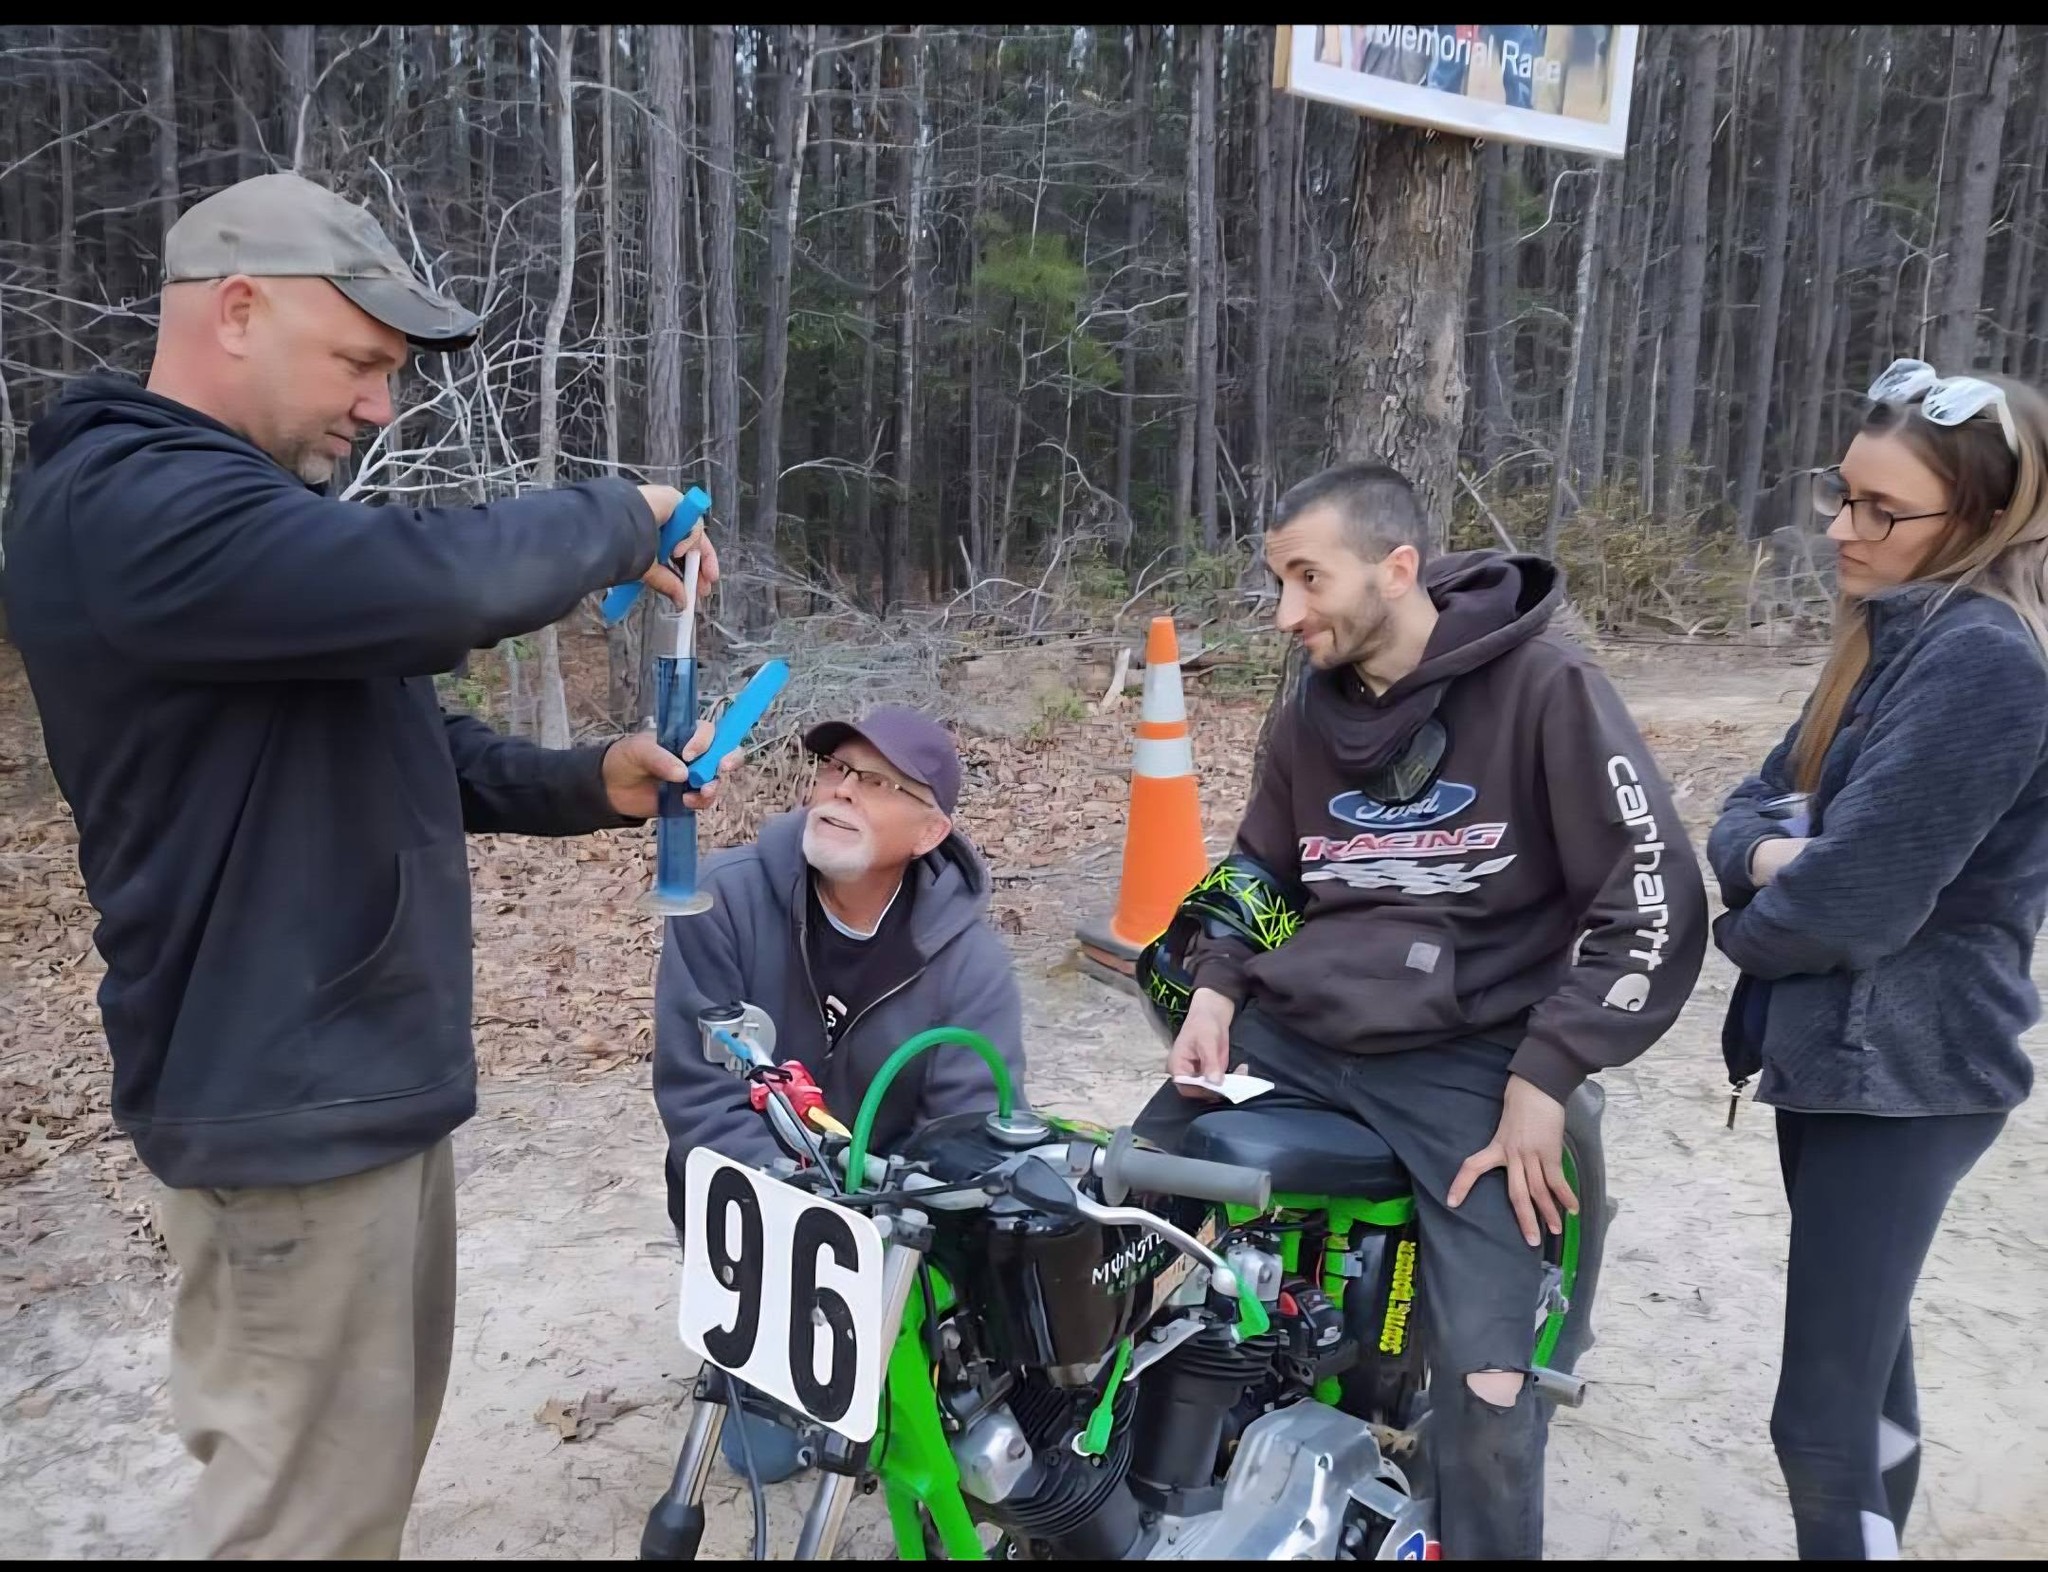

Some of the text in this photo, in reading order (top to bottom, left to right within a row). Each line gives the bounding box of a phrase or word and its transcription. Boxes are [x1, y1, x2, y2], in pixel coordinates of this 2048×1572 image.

[1376, 25, 1561, 82] Memorial Race
[1356, 791, 1440, 820] Ford
[1299, 823, 1508, 862] RACING
[703, 1166, 859, 1423] 96
